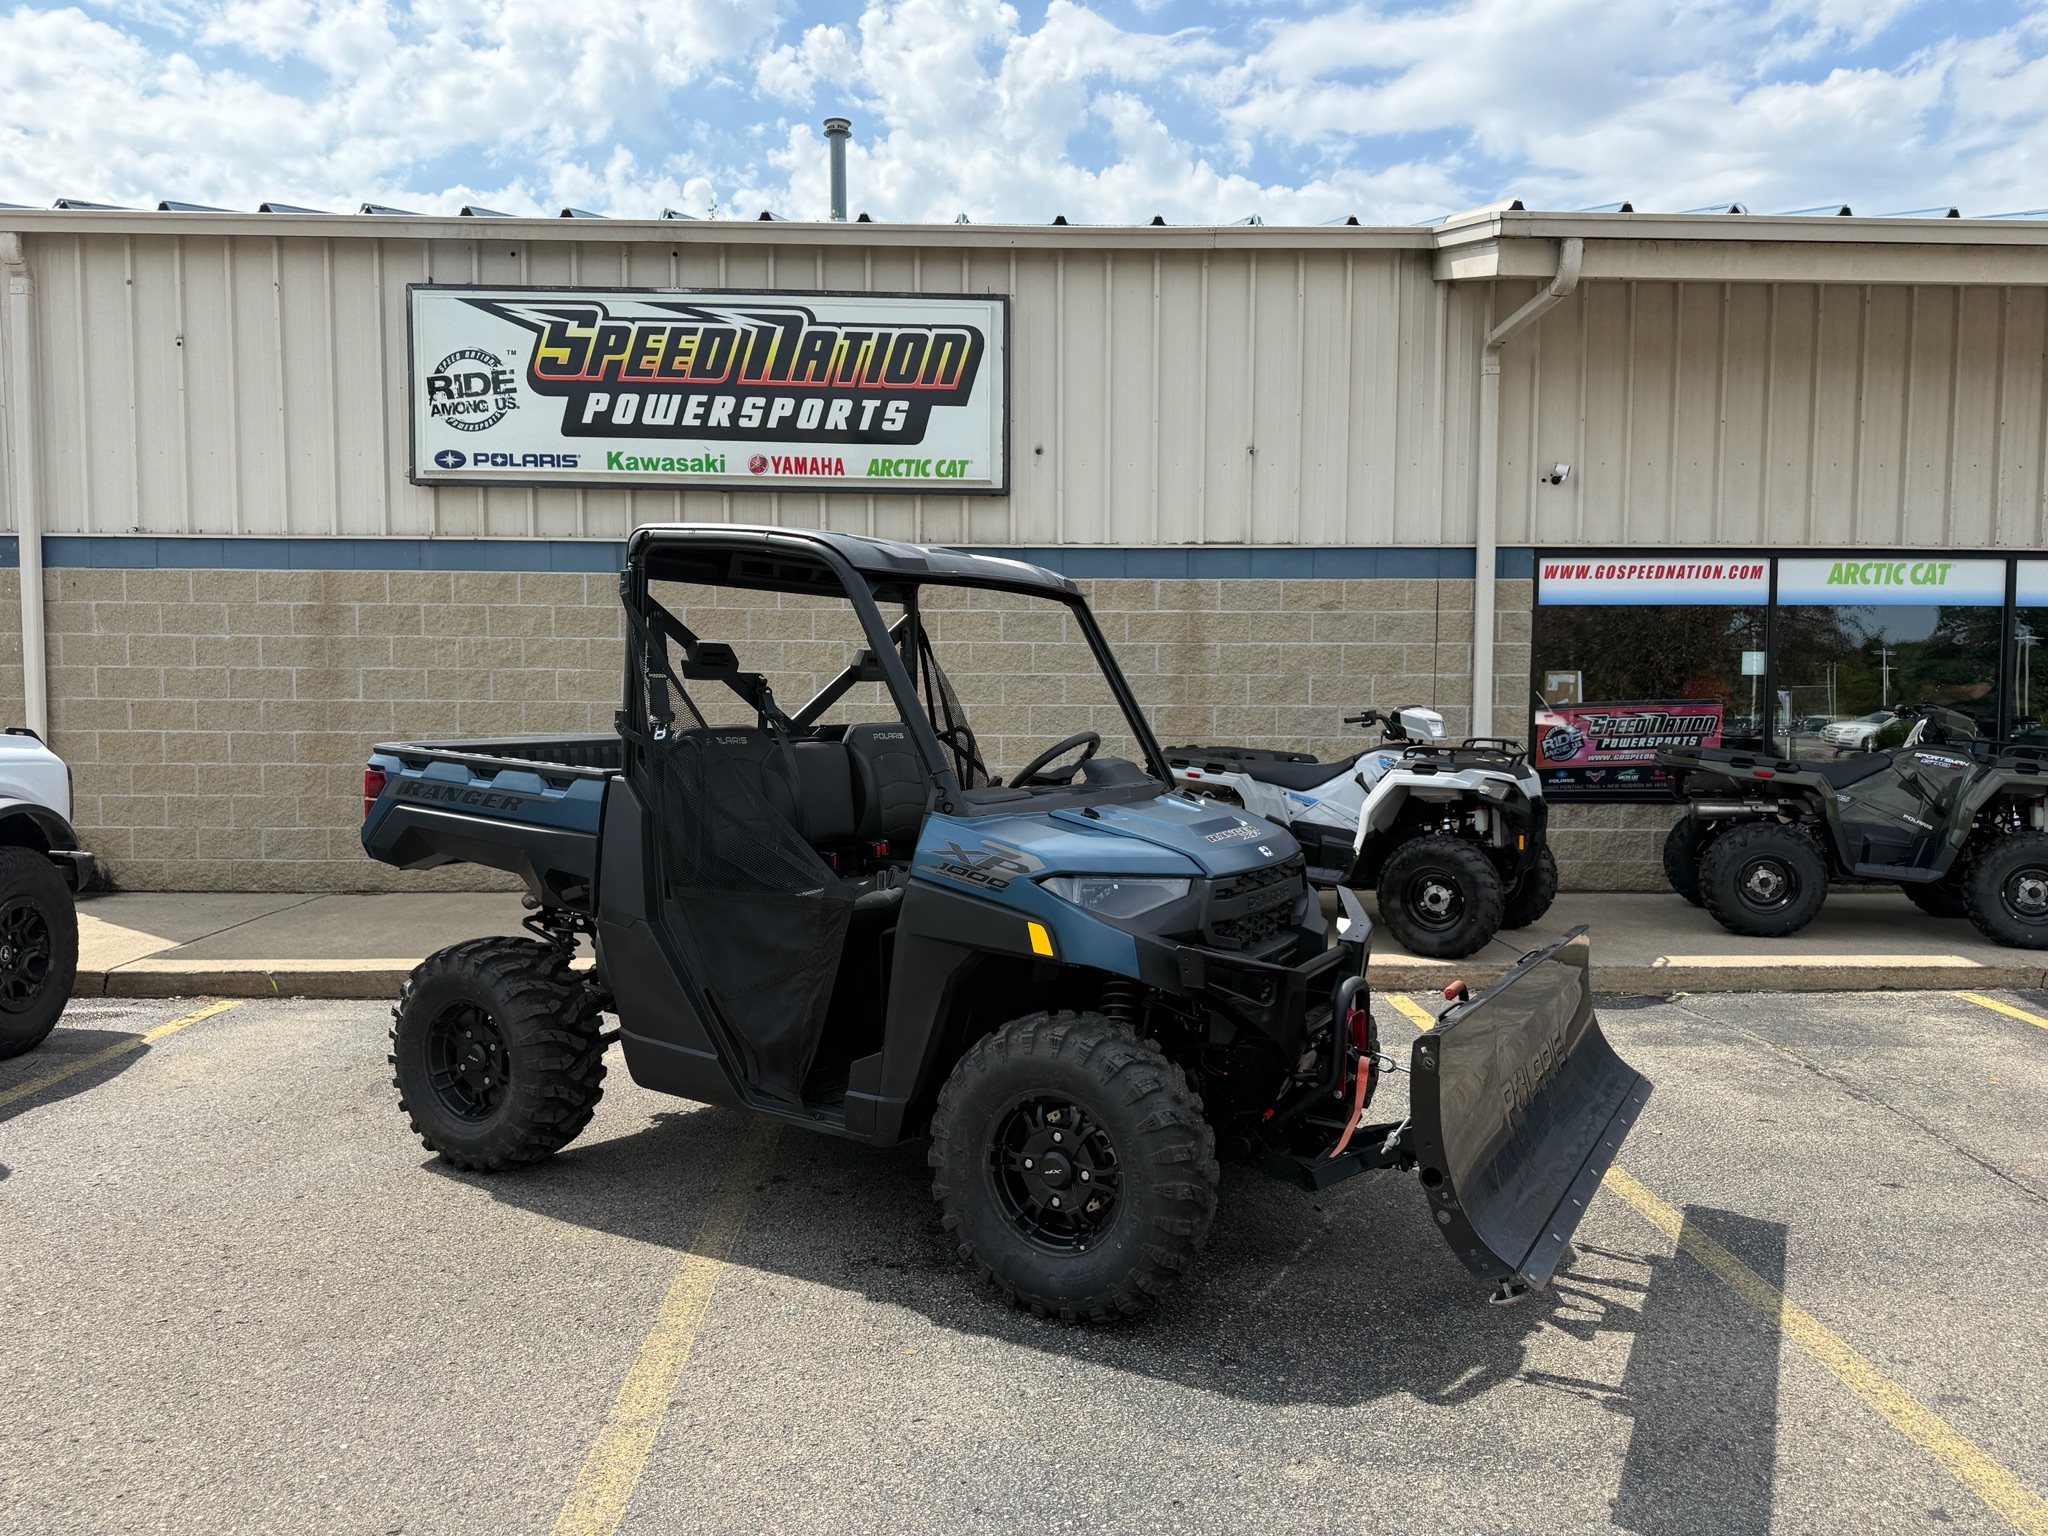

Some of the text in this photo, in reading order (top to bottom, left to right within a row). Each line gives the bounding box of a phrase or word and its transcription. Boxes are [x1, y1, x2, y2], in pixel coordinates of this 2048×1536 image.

[438, 352, 462, 373] SPEED
[426, 369, 517, 402] RIDE
[431, 399, 489, 417] AMONG
[582, 392, 910, 431] POWERSPORTS
[447, 411, 502, 431] POWERSPORTS
[472, 453, 578, 469] POLARIS
[606, 451, 727, 474] Kawasaki
[771, 456, 845, 476] YAMAHA
[867, 458, 969, 478] ARCTIC CAT
[1543, 564, 1764, 581] WWW.GOSPEEDNATION.COM
[1826, 562, 1953, 585] ARCTIC CAT
[873, 732, 904, 740] POLARIS
[1542, 733, 1582, 752] RIDE
[1601, 736, 1698, 749] POWERSPORTS
[1914, 752, 1969, 766] SPORTSMAN
[396, 781, 525, 811] RANGER
[1903, 813, 1934, 830] POLARIS
[1205, 826, 1261, 842] RANGER
[939, 862, 1012, 890] 1000
[1247, 885, 1289, 911] POLARIS
